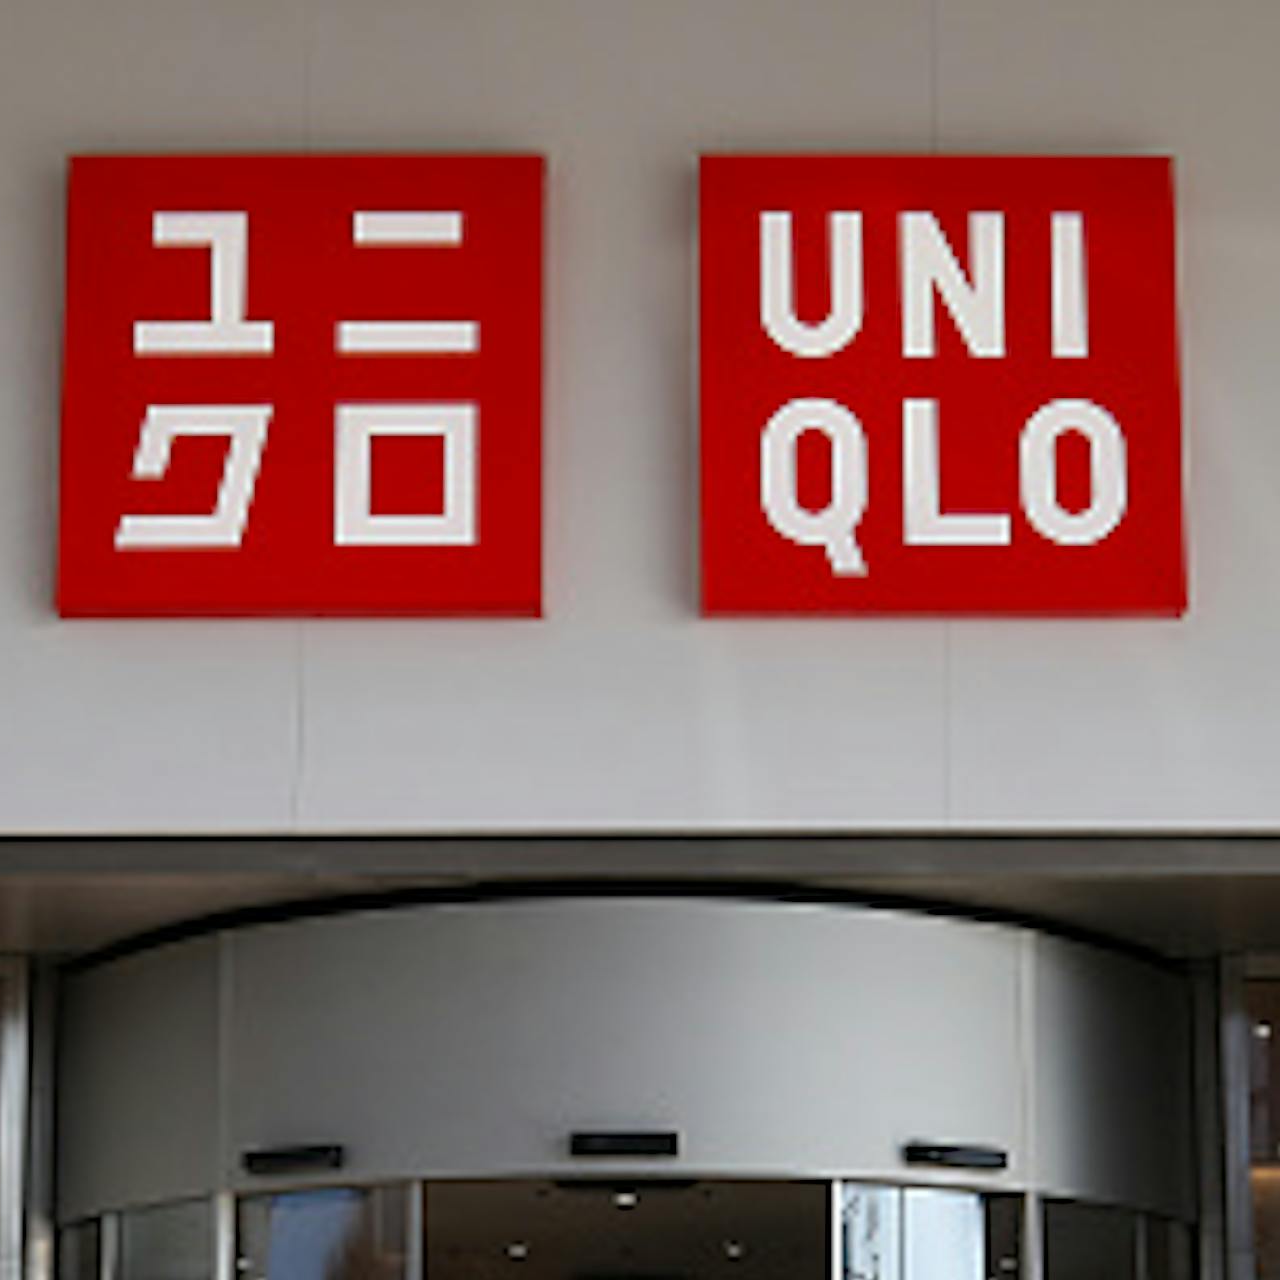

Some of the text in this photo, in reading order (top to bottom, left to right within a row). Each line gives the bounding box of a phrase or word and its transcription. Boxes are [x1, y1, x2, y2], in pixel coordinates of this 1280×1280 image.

[133, 211, 479, 355] ユニ
[760, 211, 1089, 358] UNI
[114, 403, 478, 549] クロ
[760, 397, 1128, 577] QLO
